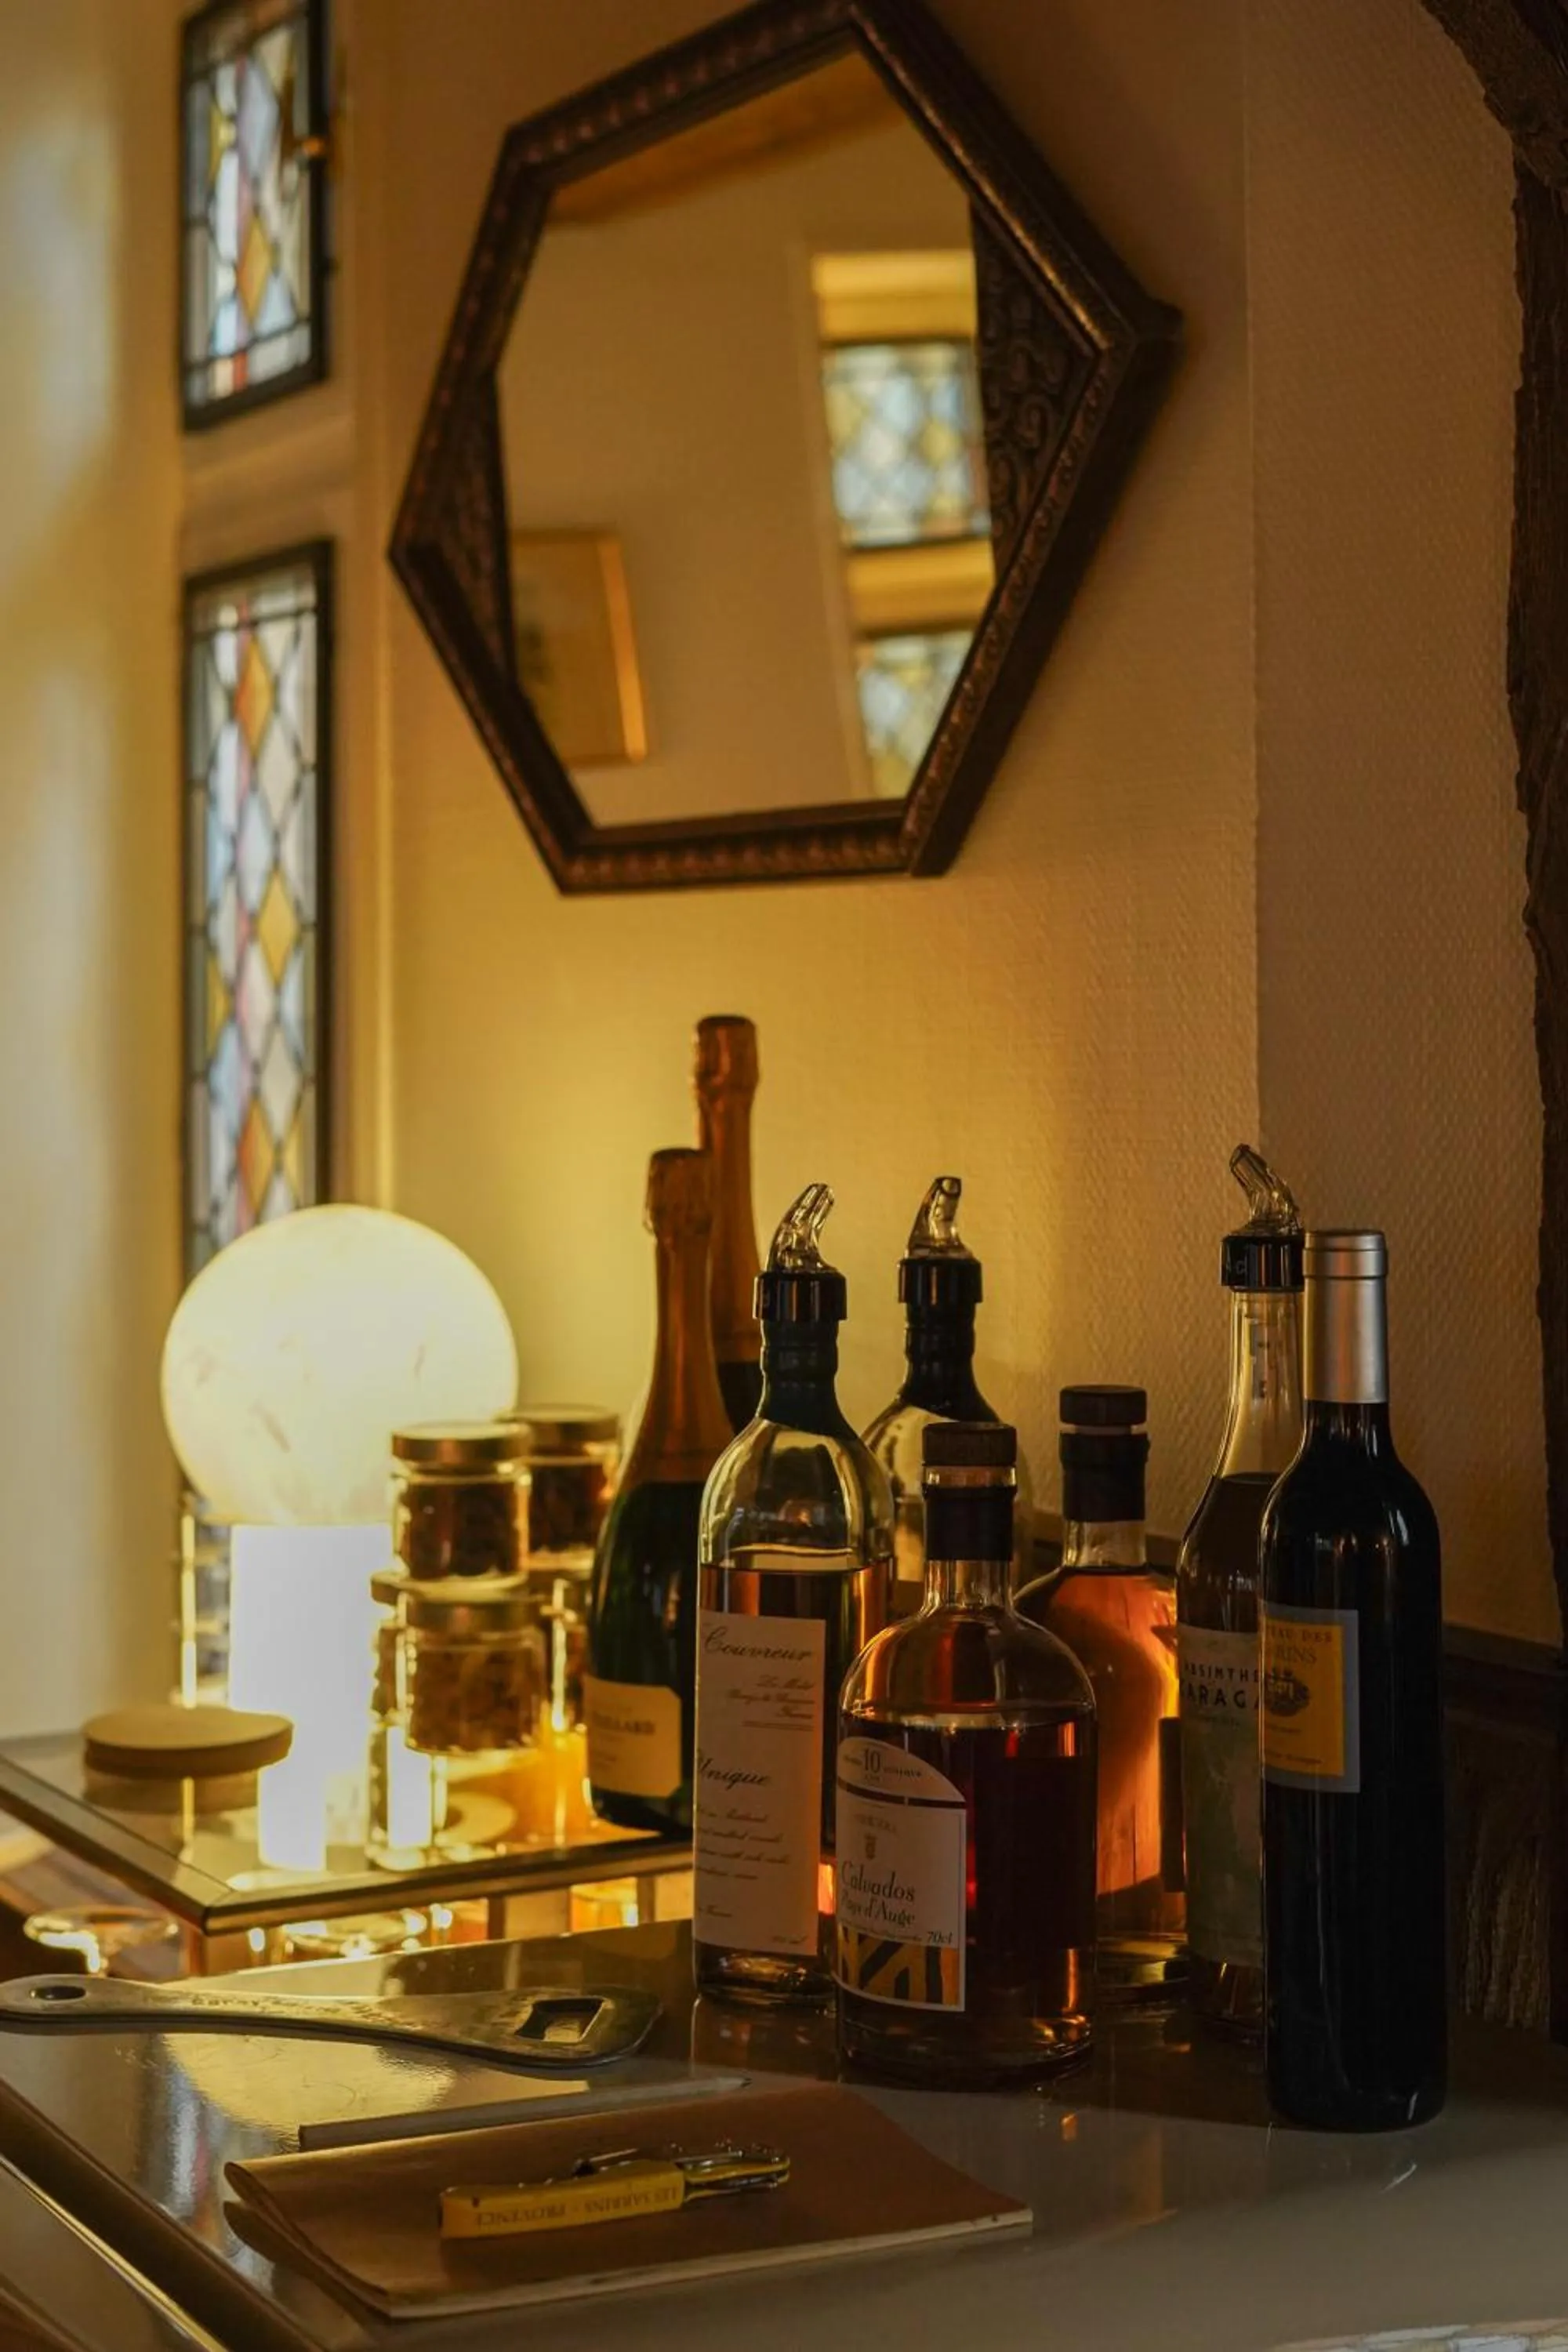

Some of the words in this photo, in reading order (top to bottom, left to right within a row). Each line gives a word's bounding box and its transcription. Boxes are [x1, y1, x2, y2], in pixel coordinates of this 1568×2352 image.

[703, 1624, 815, 1661] Couvreur
[863, 1747, 881, 1774] 10
[841, 1860, 916, 1903] Calvados
[474, 2201, 565, 2227] PROVENCE
